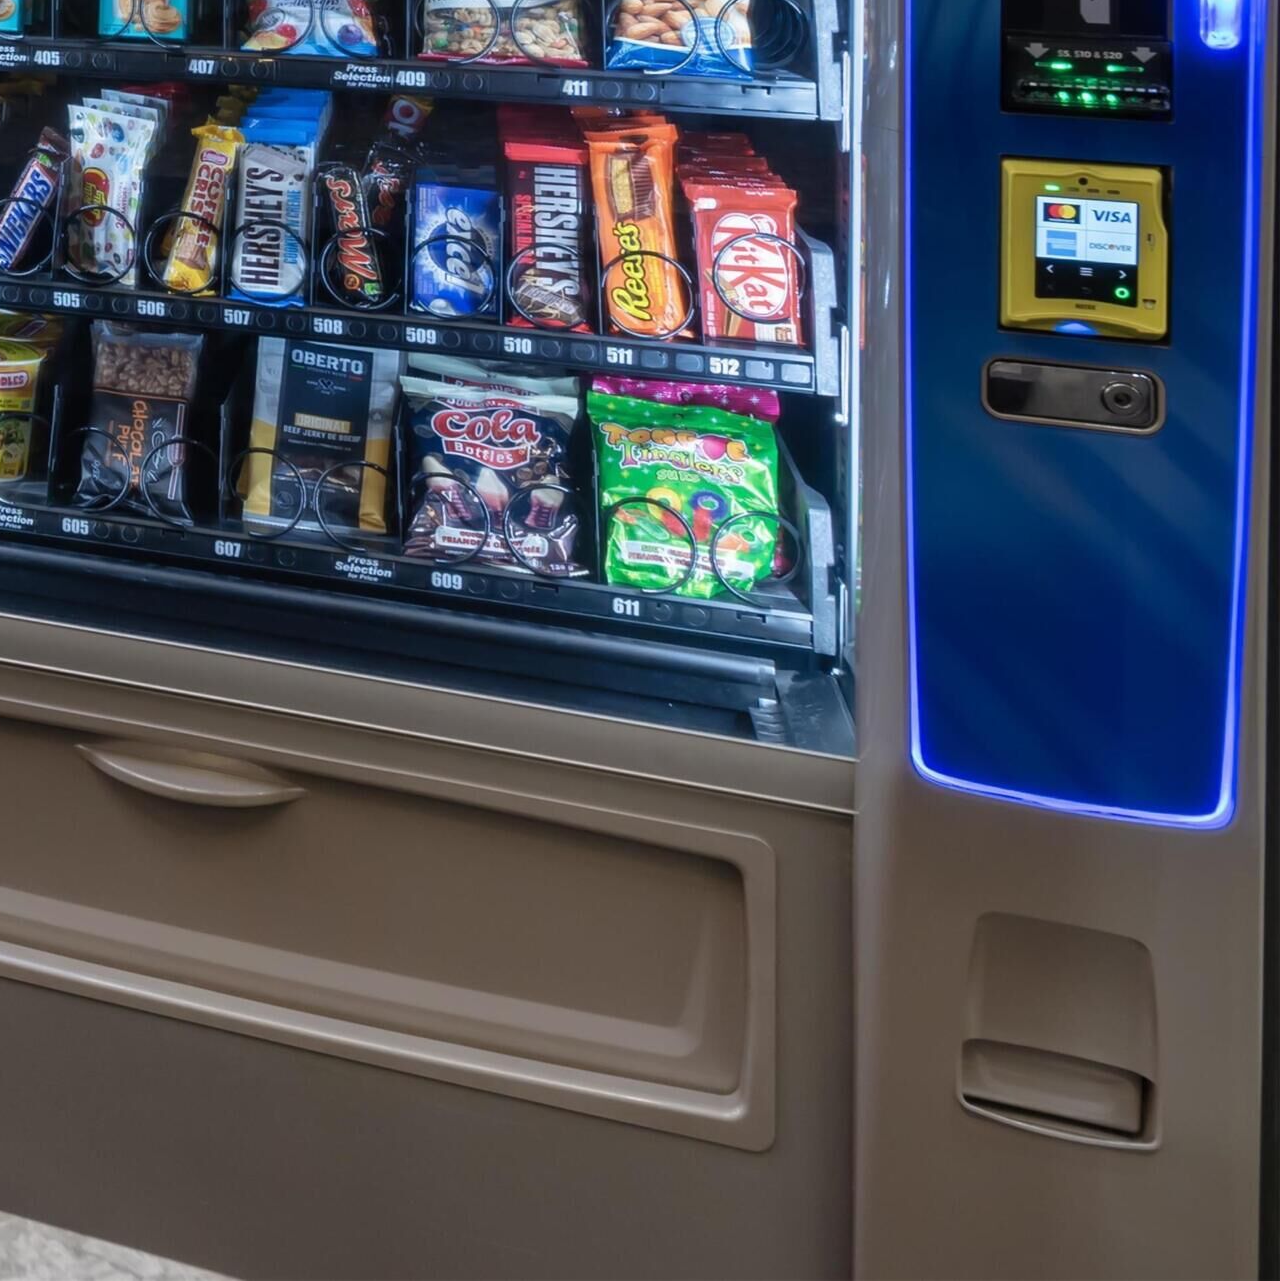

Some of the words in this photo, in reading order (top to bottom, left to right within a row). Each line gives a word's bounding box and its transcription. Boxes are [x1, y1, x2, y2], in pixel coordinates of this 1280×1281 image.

[34, 51, 60, 66] 405
[1073, 50, 1092, 59] $10
[1093, 51, 1101, 59] &
[1102, 51, 1123, 60] $20
[189, 60, 215, 74] 407
[395, 71, 425, 86] 409
[563, 80, 588, 96] 411
[1092, 210, 1133, 224] VISA
[240, 166, 285, 287] HERSHEY'S
[326, 175, 378, 281] Mars
[534, 166, 580, 296] HERSHEY'S
[444, 206, 485, 295] Excel
[713, 225, 780, 266] Kit
[1089, 242, 1133, 253] DISCOVER
[612, 221, 654, 322] Reese's
[716, 265, 788, 314] Kat
[53, 292, 80, 307] 505
[138, 300, 165, 316] 506
[224, 310, 250, 325] 507
[313, 319, 343, 335] 508
[406, 328, 436, 344] 509
[504, 337, 532, 353] 510
[290, 348, 365, 375] OBERTO
[607, 348, 633, 364] 511
[710, 358, 740, 375] 512
[431, 409, 542, 445] Cola
[454, 442, 515, 464] Bottles
[620, 440, 745, 484] Tinglers
[62, 519, 89, 534] 605
[215, 542, 241, 557] 607
[348, 556, 379, 566] Press
[336, 561, 392, 578] Selection
[432, 572, 462, 589] 609
[613, 599, 640, 616] 611
